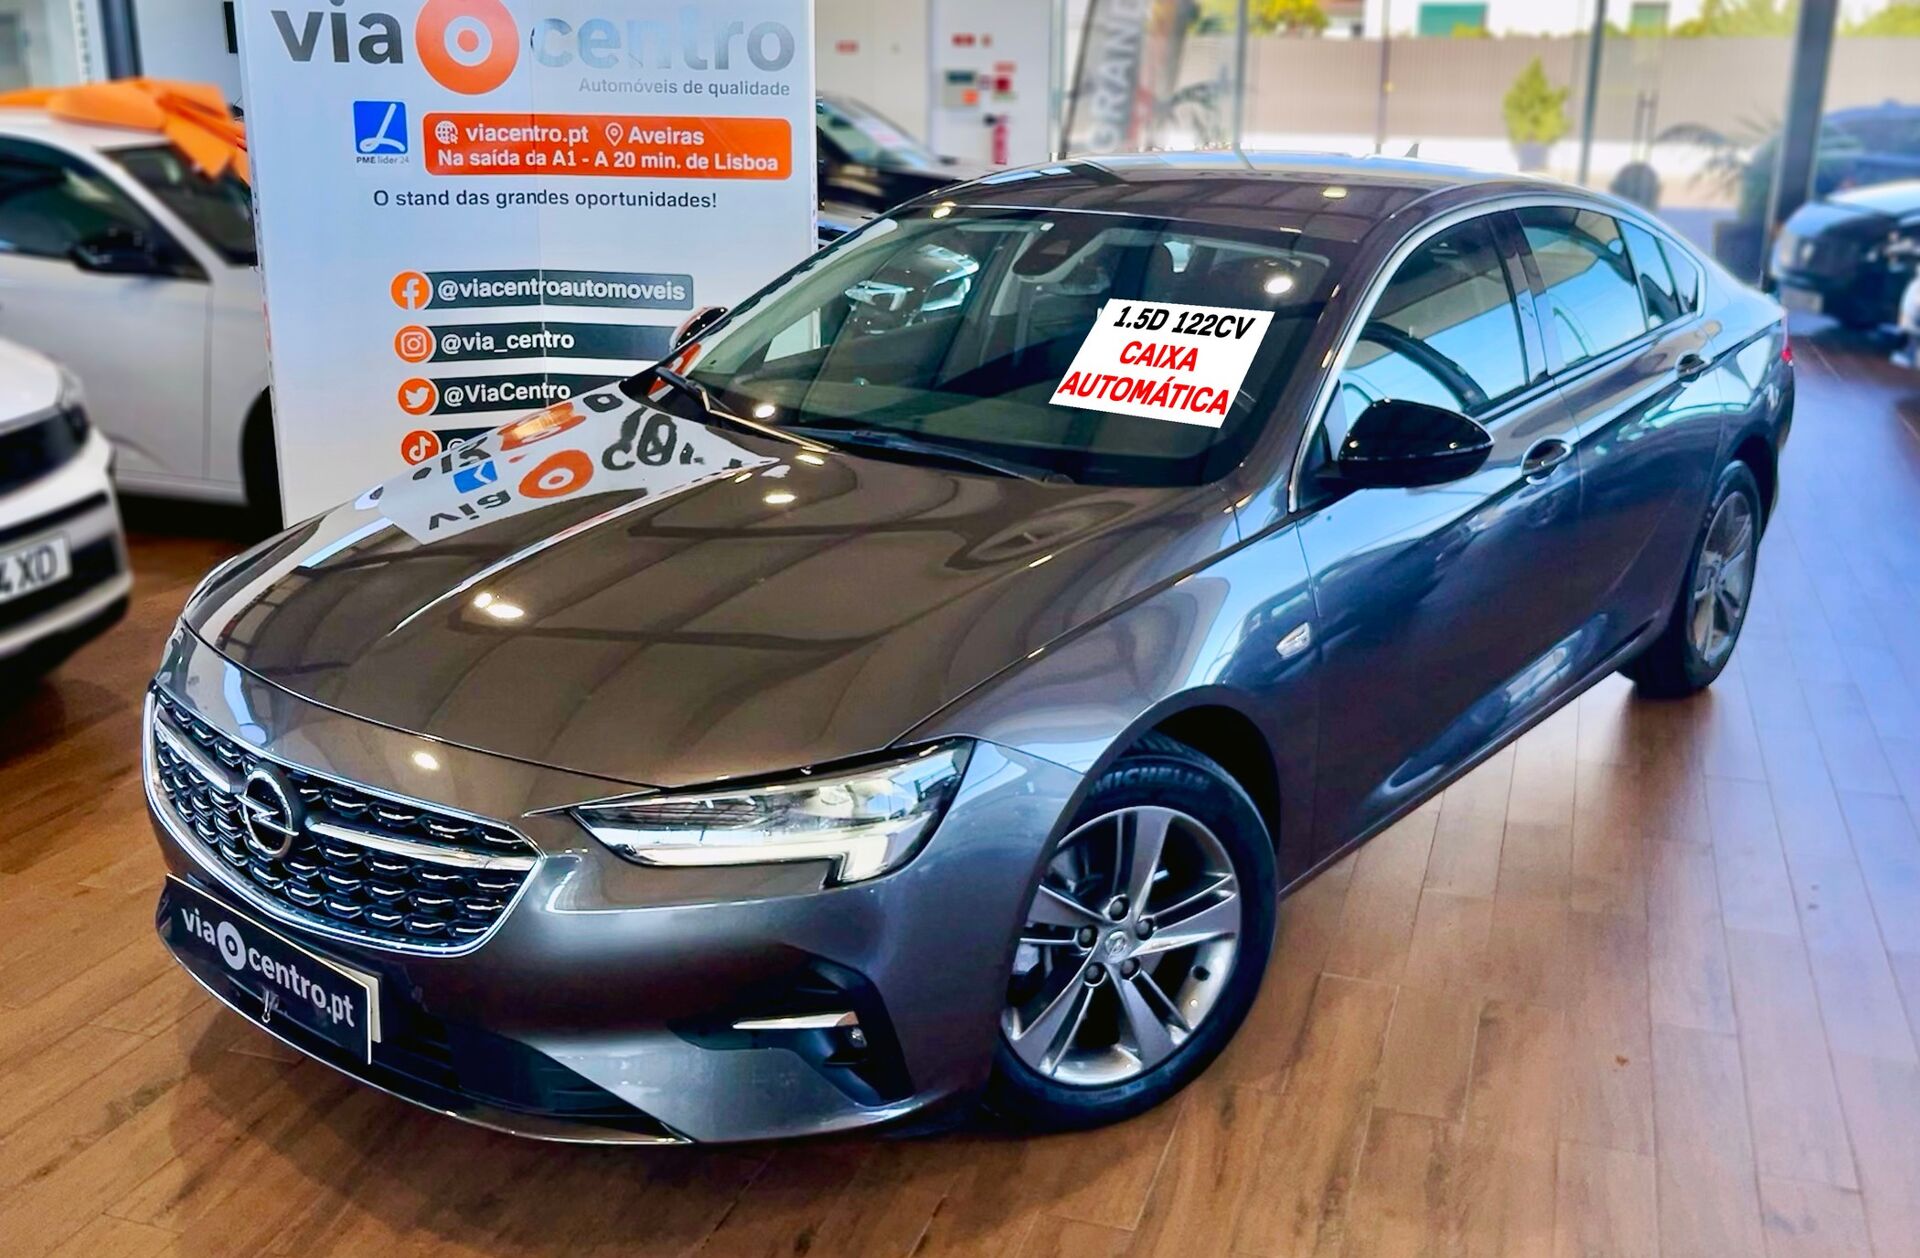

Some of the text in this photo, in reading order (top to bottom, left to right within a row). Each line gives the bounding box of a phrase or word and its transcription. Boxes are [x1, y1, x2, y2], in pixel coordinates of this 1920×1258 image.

[271, 0, 796, 71] via centro
[579, 78, 790, 98] Automóveis de qualidade
[466, 124, 705, 145] viacentro.pt Aveiras
[356, 156, 376, 164] PME
[438, 149, 464, 167] Na
[469, 147, 519, 167] saída
[526, 149, 547, 167] da
[552, 150, 577, 168] A1
[594, 150, 609, 168] A
[613, 150, 636, 169] 20
[641, 151, 681, 170] min.
[686, 152, 709, 170] de
[714, 152, 778, 171] Lisboa
[373, 189, 717, 209] O stand das grandes oportunidades!
[437, 276, 686, 301] @viacentroautomoveis
[441, 330, 575, 355] @via_centro
[444, 382, 571, 407] @ViaCentro
[181, 908, 355, 1028] via centro.pt
